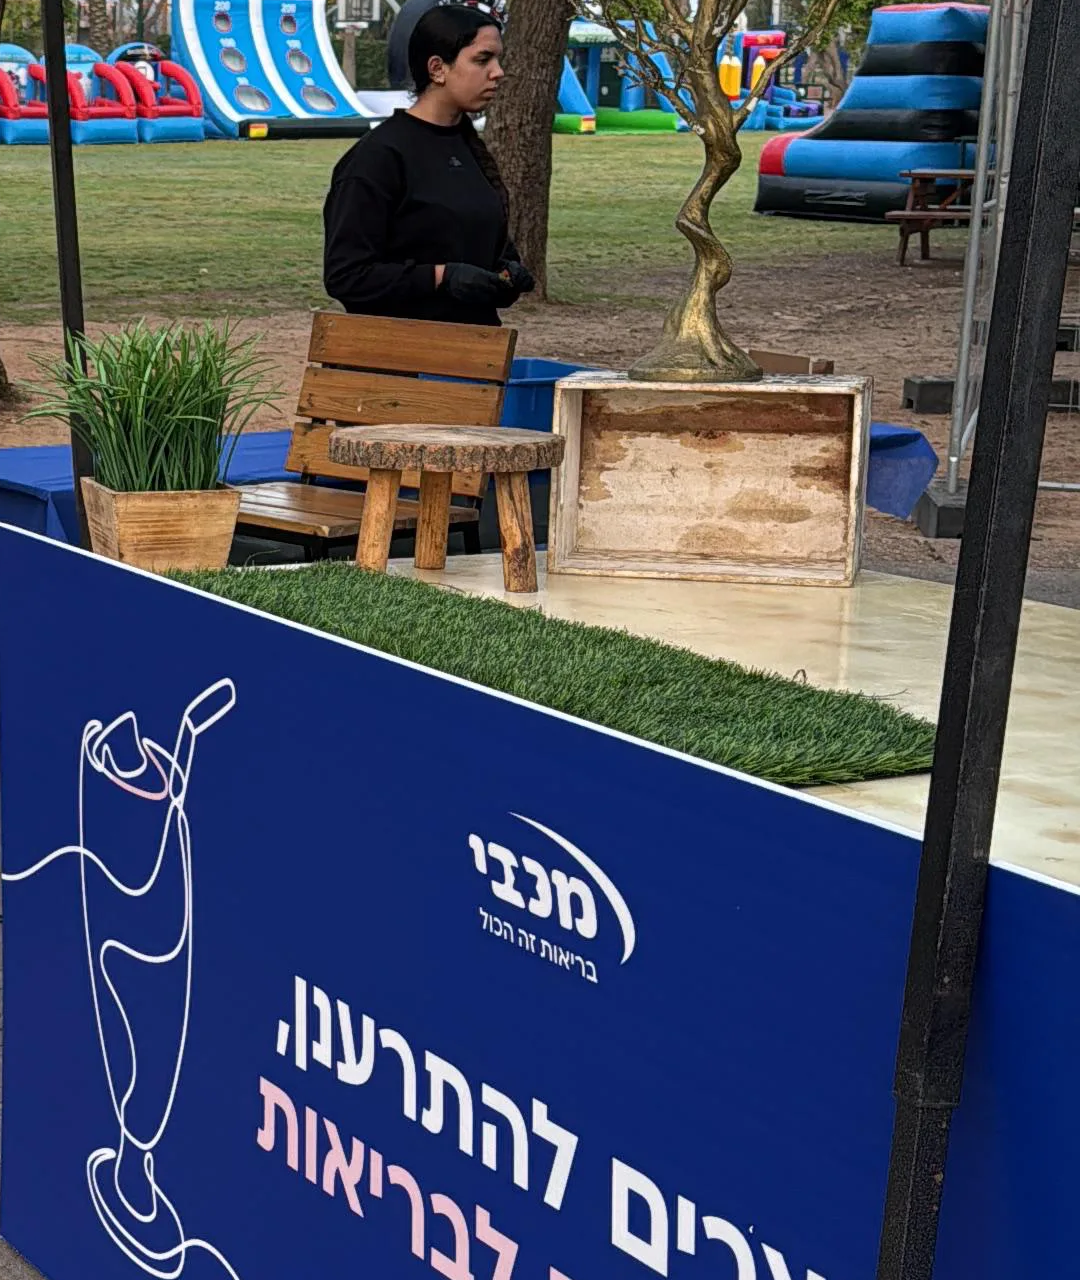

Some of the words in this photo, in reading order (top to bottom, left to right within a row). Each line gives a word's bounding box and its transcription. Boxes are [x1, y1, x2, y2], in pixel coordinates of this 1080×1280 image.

[469, 833, 598, 939] מכבי
[479, 906, 514, 943] הכול
[518, 928, 536, 953] זה
[540, 938, 599, 984] בריאות
[276, 975, 579, 1211] להתרענן,
